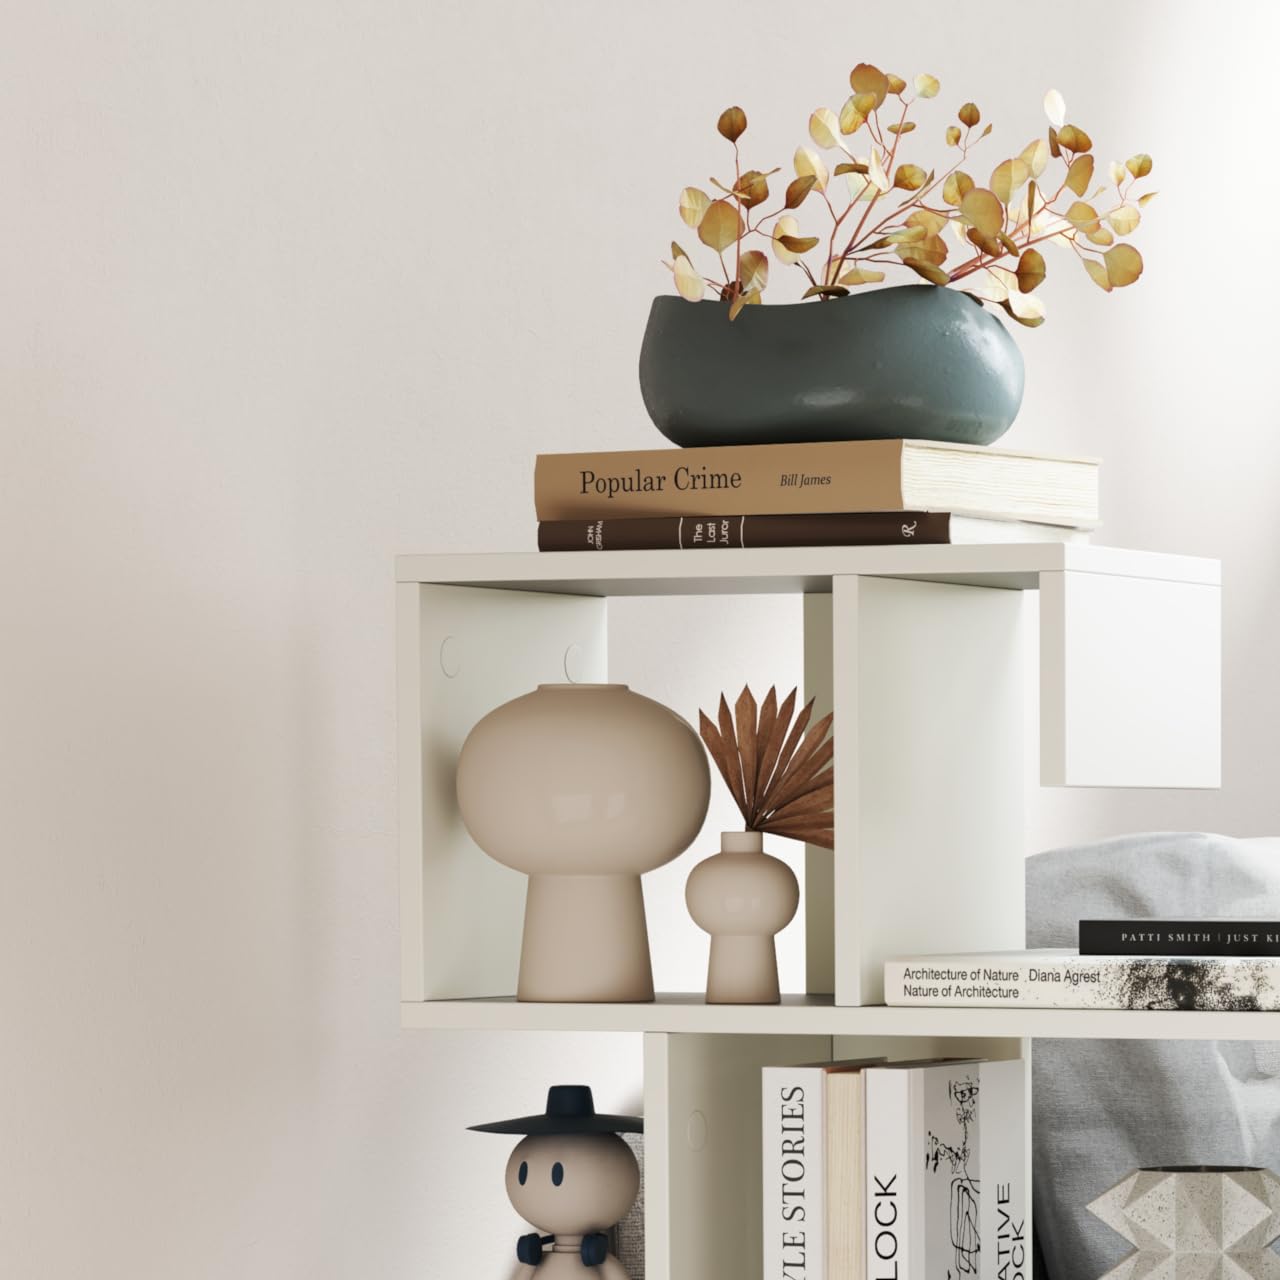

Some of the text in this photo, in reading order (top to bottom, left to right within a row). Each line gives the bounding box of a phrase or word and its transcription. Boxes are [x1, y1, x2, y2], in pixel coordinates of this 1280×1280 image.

[579, 465, 742, 499] Popular Crime
[780, 473, 832, 489] Bill James
[693, 523, 703, 543] The
[706, 522, 716, 543] Last
[719, 519, 729, 545] Juror
[1121, 932, 1161, 942] PATTI
[1167, 932, 1211, 943] SMITH
[1226, 933, 1259, 945] JUST
[903, 967, 1019, 982] Architecture of Nature
[1028, 968, 1101, 986] Diana Agrest
[903, 984, 1019, 999] Nature of Architecture
[780, 1086, 806, 1223] STORIES
